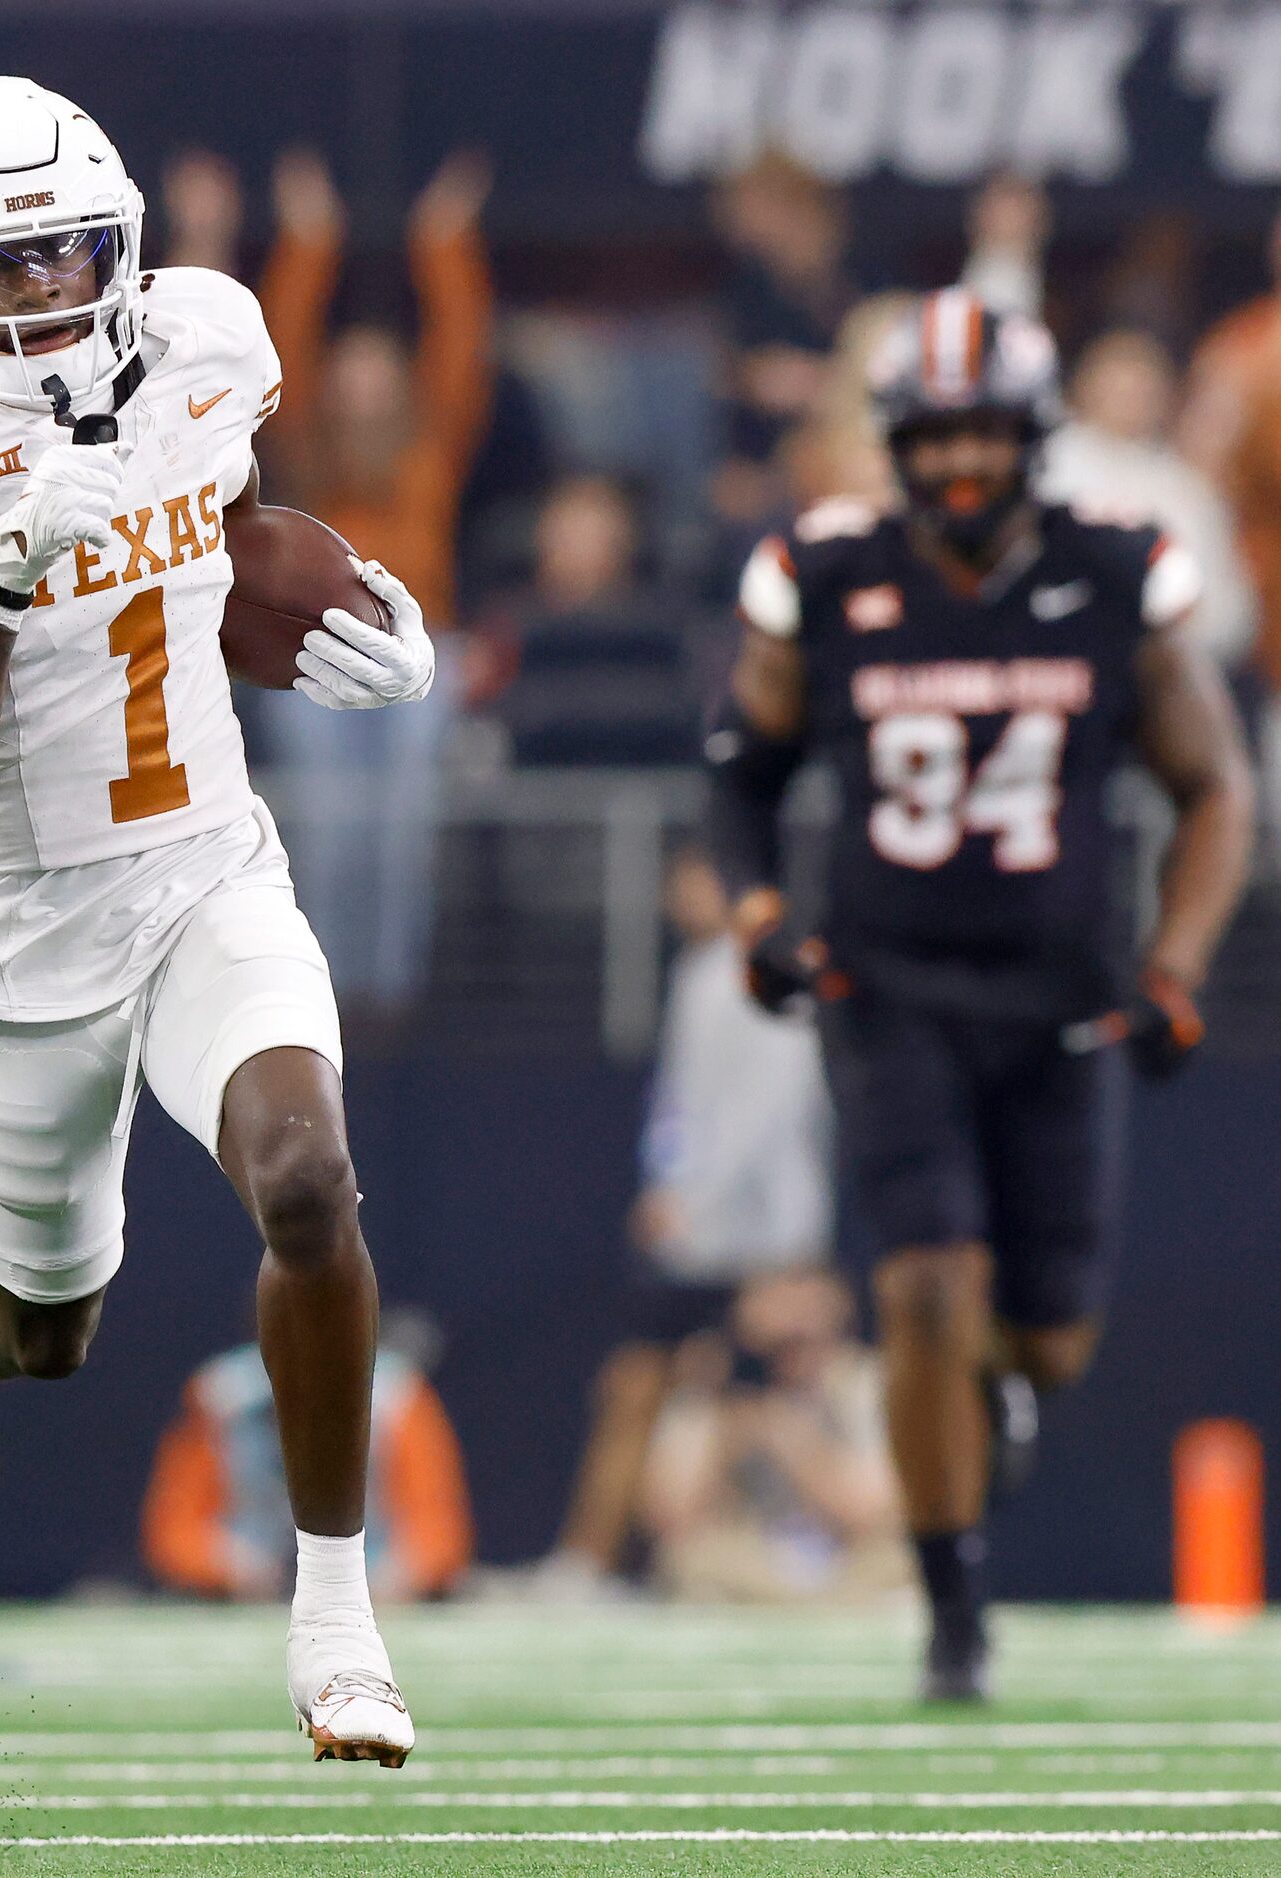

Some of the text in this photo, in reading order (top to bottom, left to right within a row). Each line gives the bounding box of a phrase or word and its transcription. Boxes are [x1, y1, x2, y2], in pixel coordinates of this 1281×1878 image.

[4, 191, 56, 213] HORNS
[108, 585, 191, 824] 1
[867, 711, 1065, 870] 94
